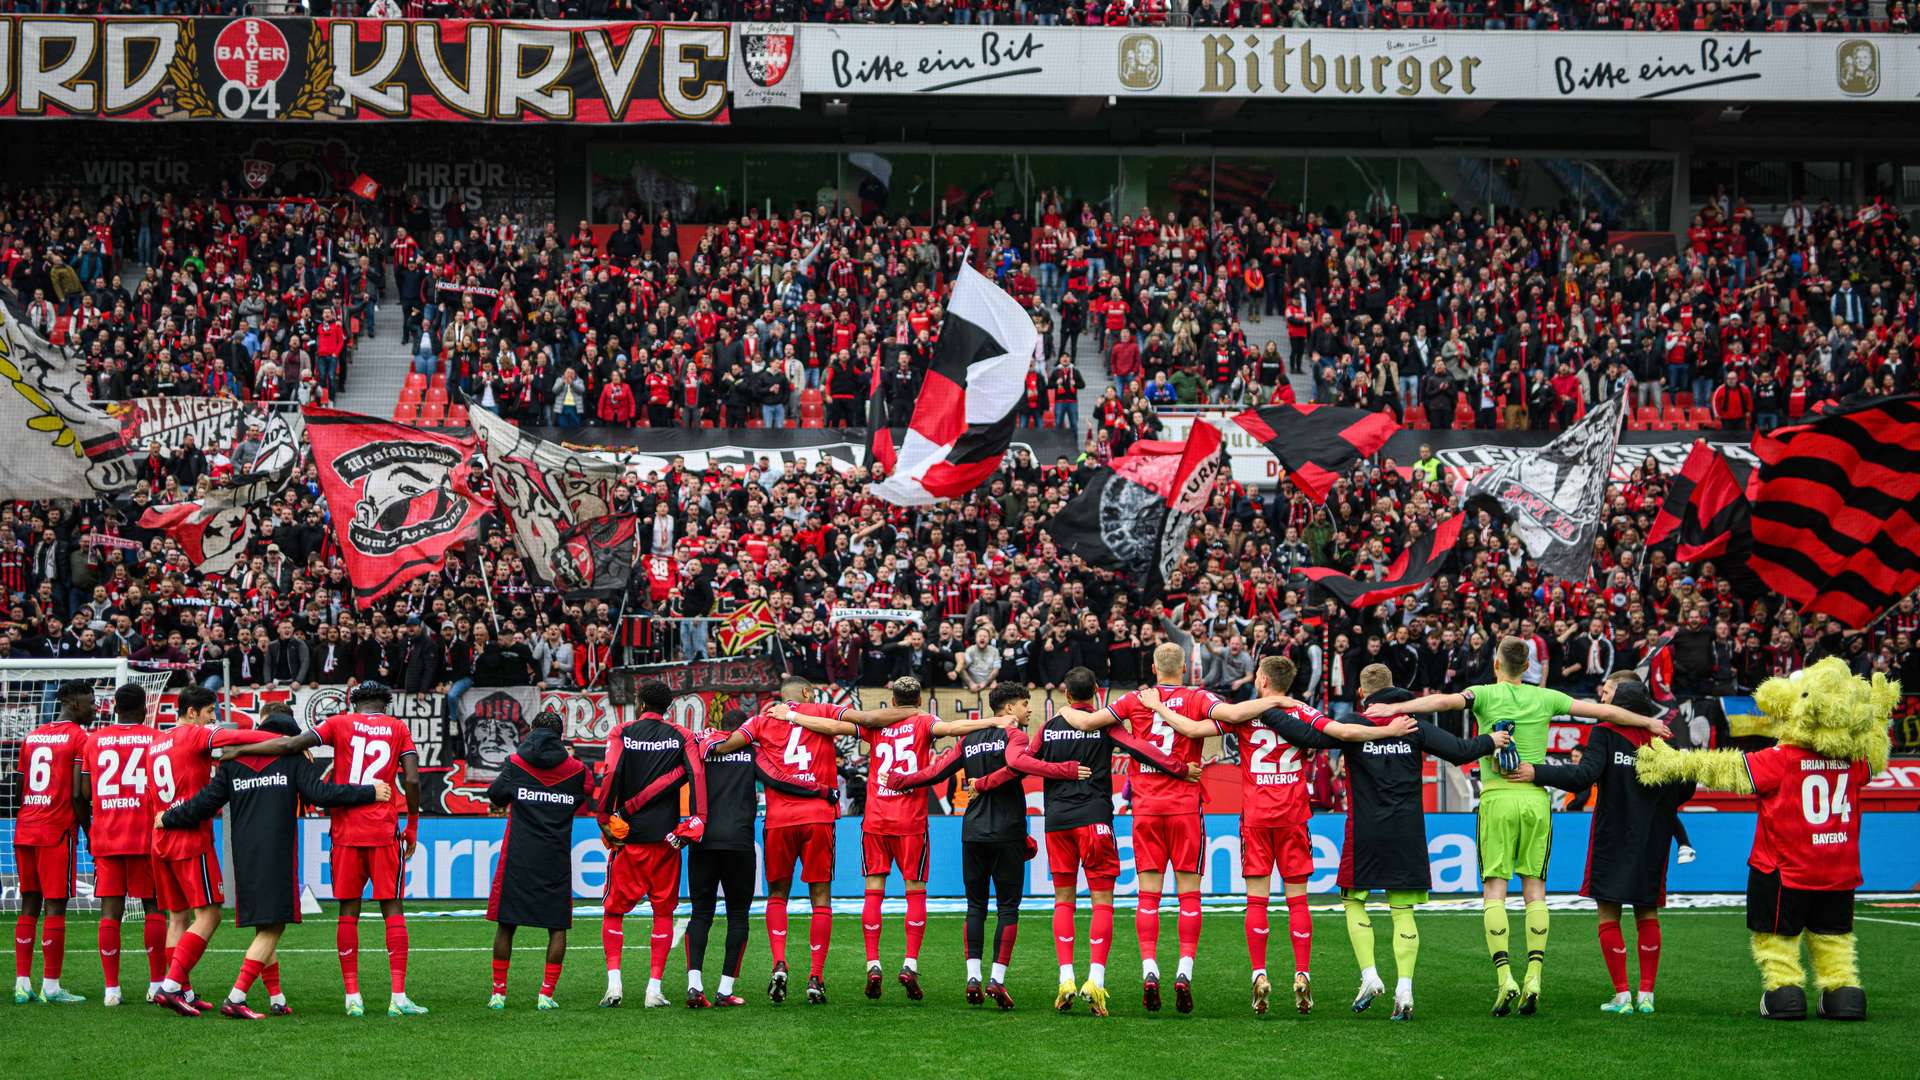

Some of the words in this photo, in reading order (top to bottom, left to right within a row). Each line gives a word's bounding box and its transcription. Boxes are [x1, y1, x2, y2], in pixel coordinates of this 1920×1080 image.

[217, 46, 286, 61] BAYER
[245, 20, 260, 87] BAYER
[328, 20, 730, 120] KURVE
[832, 48, 908, 88] Bitte
[917, 50, 975, 74] ein
[981, 31, 1044, 66] Bit
[1198, 33, 1482, 96] Bitburger
[1555, 56, 1630, 95] Bitte
[1638, 56, 1695, 81] ein
[1701, 38, 1762, 72] Bit
[218, 79, 281, 119] 04
[83, 161, 136, 184] WIR
[138, 157, 190, 184] FÜR
[407, 164, 451, 187] IHR
[455, 159, 505, 187] FÜR
[353, 722, 392, 736] TAPSOBA
[624, 736, 680, 751] Barmenia
[784, 727, 812, 770] 4
[1149, 711, 1174, 756] 5
[1250, 729, 1302, 774] 22
[29, 746, 52, 792] 6
[97, 747, 147, 796] 24
[153, 754, 176, 803] 9
[232, 773, 288, 792] Barmenia
[350, 736, 391, 785] 12
[875, 735, 918, 786] 25
[1801, 760, 1825, 770] BRIAN
[517, 788, 575, 805] Barmenia
[1802, 774, 1851, 825] 04
